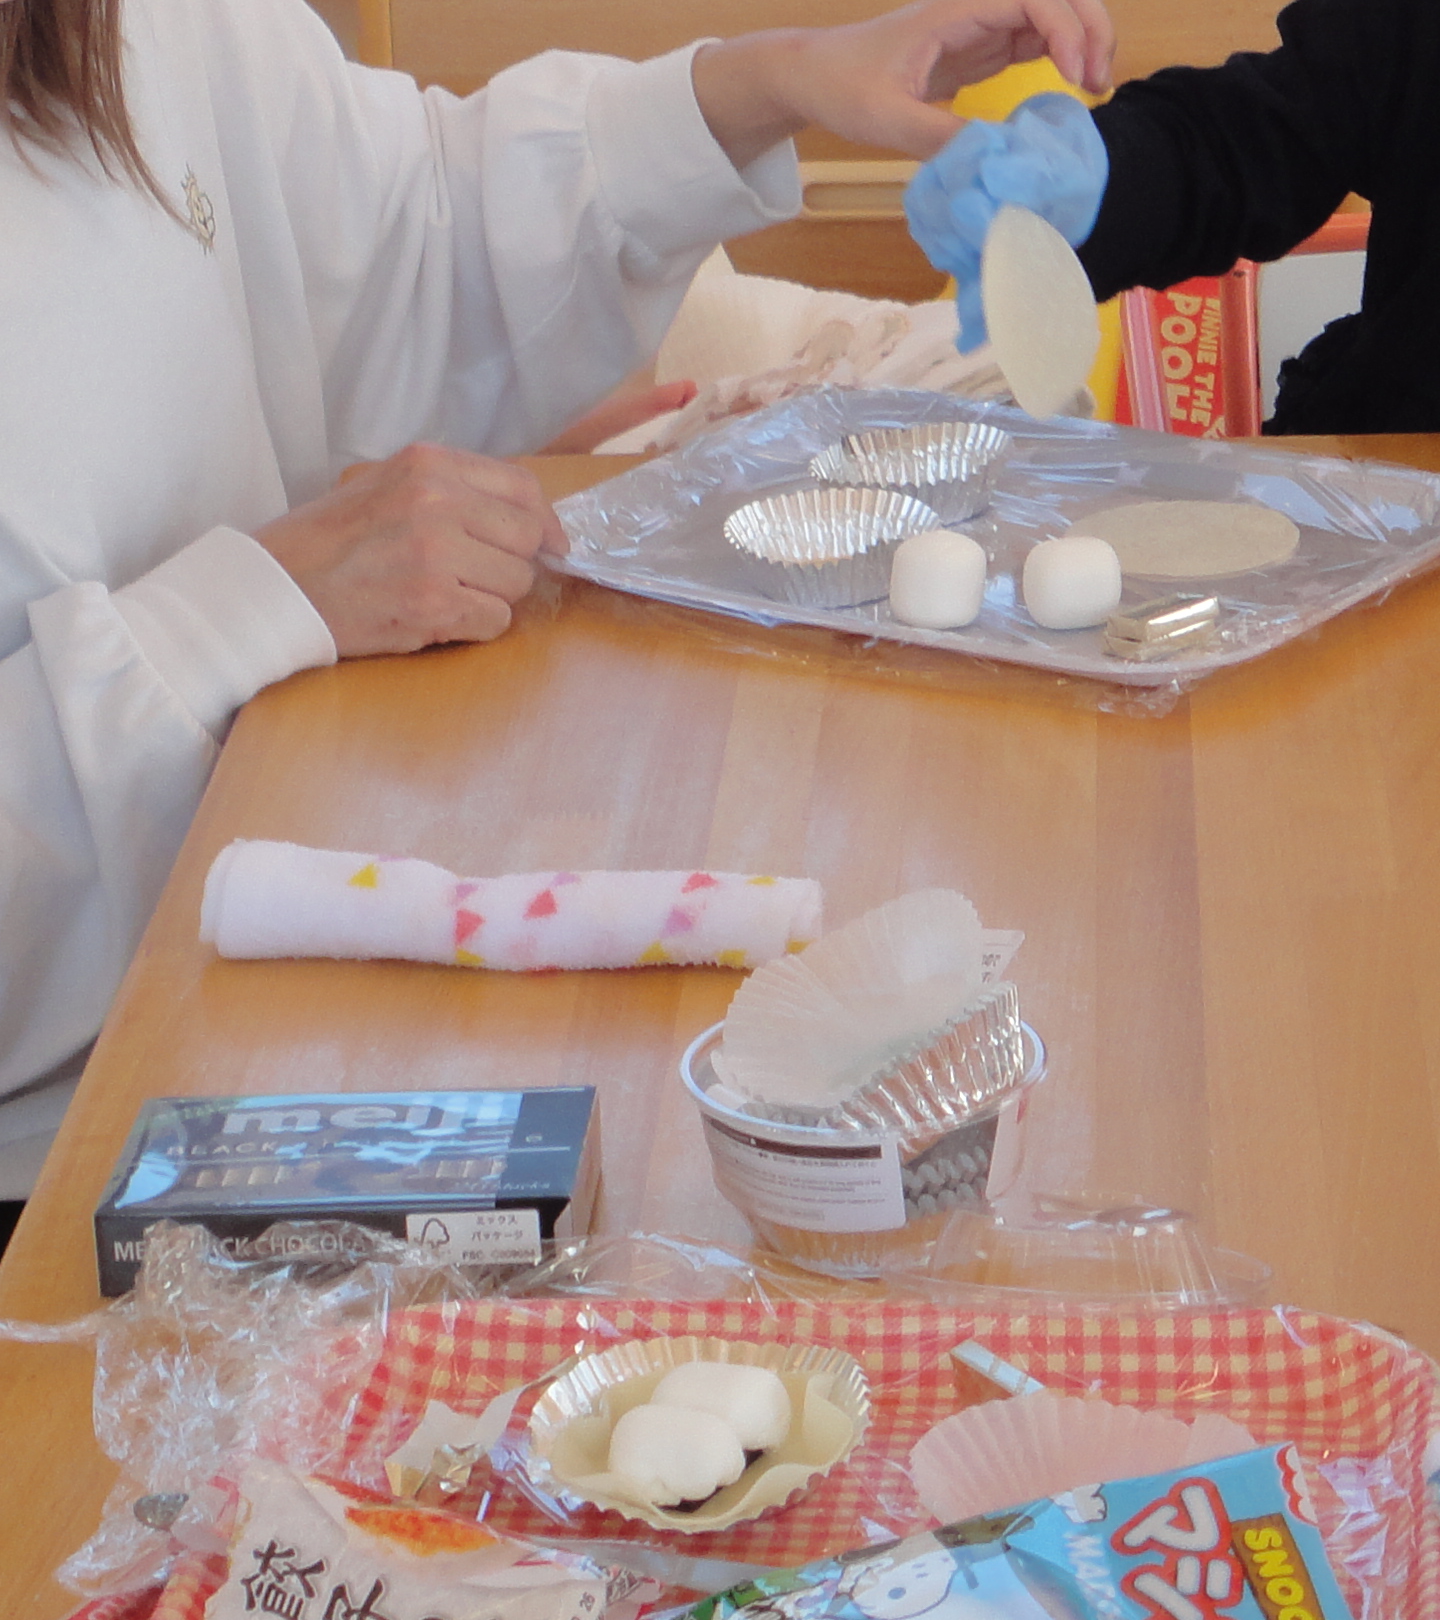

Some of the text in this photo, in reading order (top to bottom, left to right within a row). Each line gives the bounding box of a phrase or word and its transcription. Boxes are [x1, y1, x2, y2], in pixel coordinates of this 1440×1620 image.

[1190, 373, 1215, 427] THE
[476, 1213, 518, 1227] ミックス
[471, 1229, 524, 1243] パッケージ
